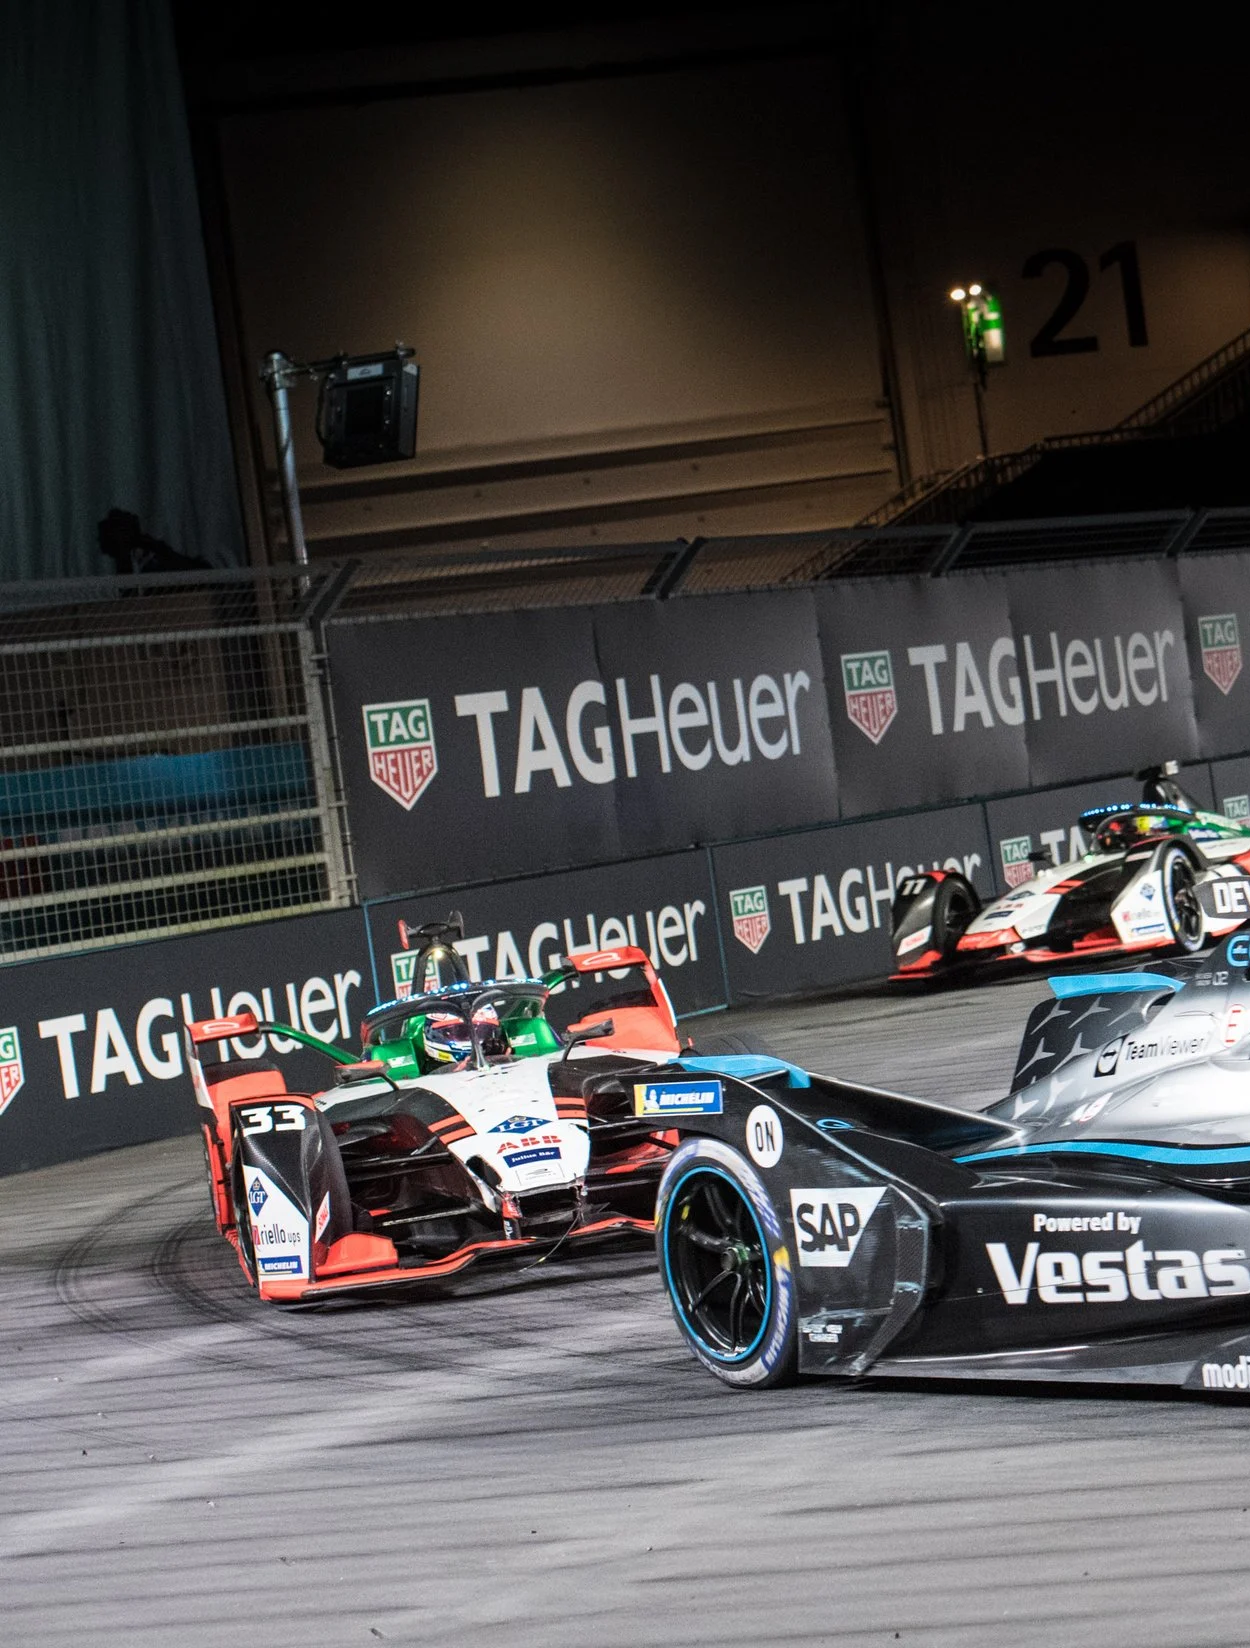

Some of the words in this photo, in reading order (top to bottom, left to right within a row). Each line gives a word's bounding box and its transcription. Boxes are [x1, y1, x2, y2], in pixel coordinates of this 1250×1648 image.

[1021, 240, 1149, 358] 21
[1203, 620, 1235, 646] TAG
[847, 661, 889, 689] TAG
[908, 630, 1173, 735] TAGHeuer
[369, 709, 428, 743] TAG
[850, 693, 895, 737] HEUER
[454, 669, 810, 798] TAGHeuer
[373, 751, 434, 799] HEUER
[1226, 801, 1248, 817] TAG
[1003, 841, 1027, 861] TAG
[733, 892, 764, 913] TAG
[778, 853, 982, 944] TAGHr
[735, 915, 767, 946] HEUER
[659, 1091, 715, 1106] MICHELIN
[241, 1105, 306, 1137] 33
[498, 1118, 543, 1132] LGT
[497, 1135, 562, 1155] ABB
[754, 1121, 776, 1152] ON
[249, 1191, 265, 1204] LGT
[260, 1224, 286, 1246] riello
[796, 1202, 861, 1254] SAP
[1033, 1212, 1102, 1233] Powered
[1107, 1212, 1142, 1236] by
[264, 1260, 299, 1271] MICHELIN
